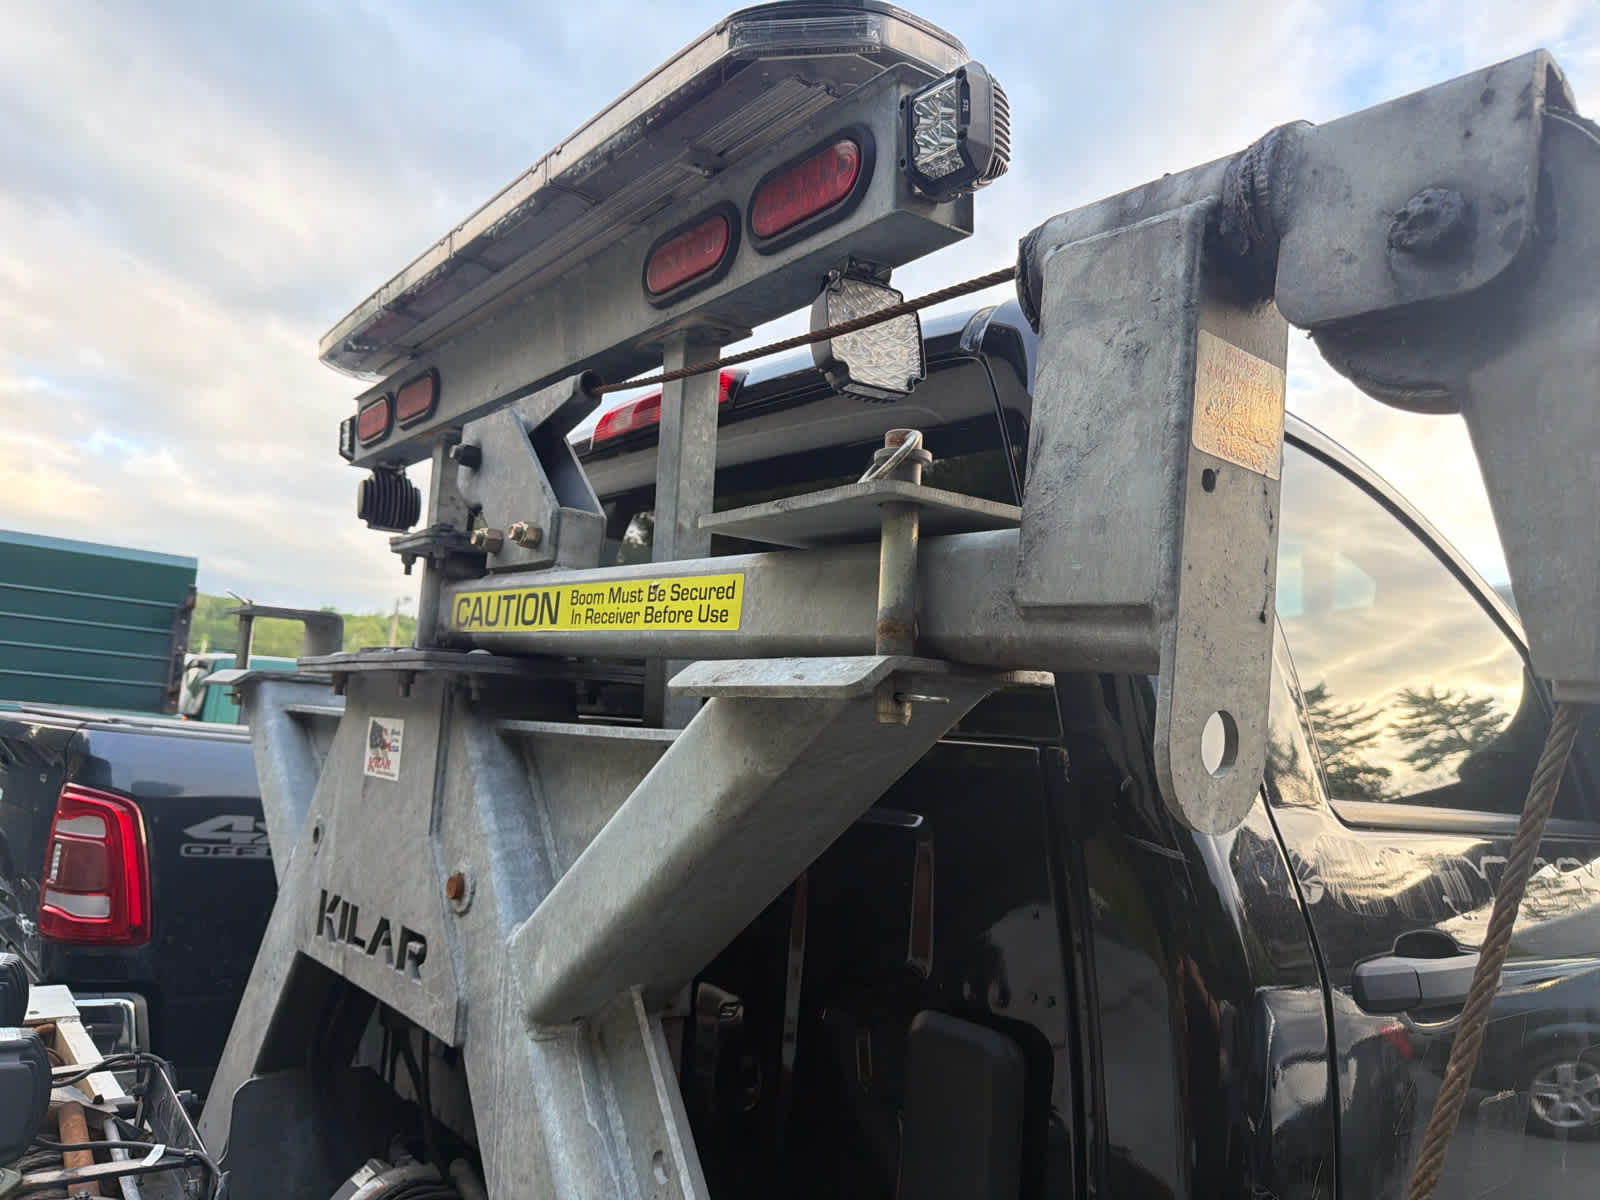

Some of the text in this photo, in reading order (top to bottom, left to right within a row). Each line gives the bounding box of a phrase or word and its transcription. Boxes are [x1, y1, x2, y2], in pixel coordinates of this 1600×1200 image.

[571, 580, 735, 605] Boom Must Be Secured
[456, 591, 561, 627] CAUTION
[571, 604, 729, 625] In Receiver Before Use
[316, 888, 428, 980] KILAR
